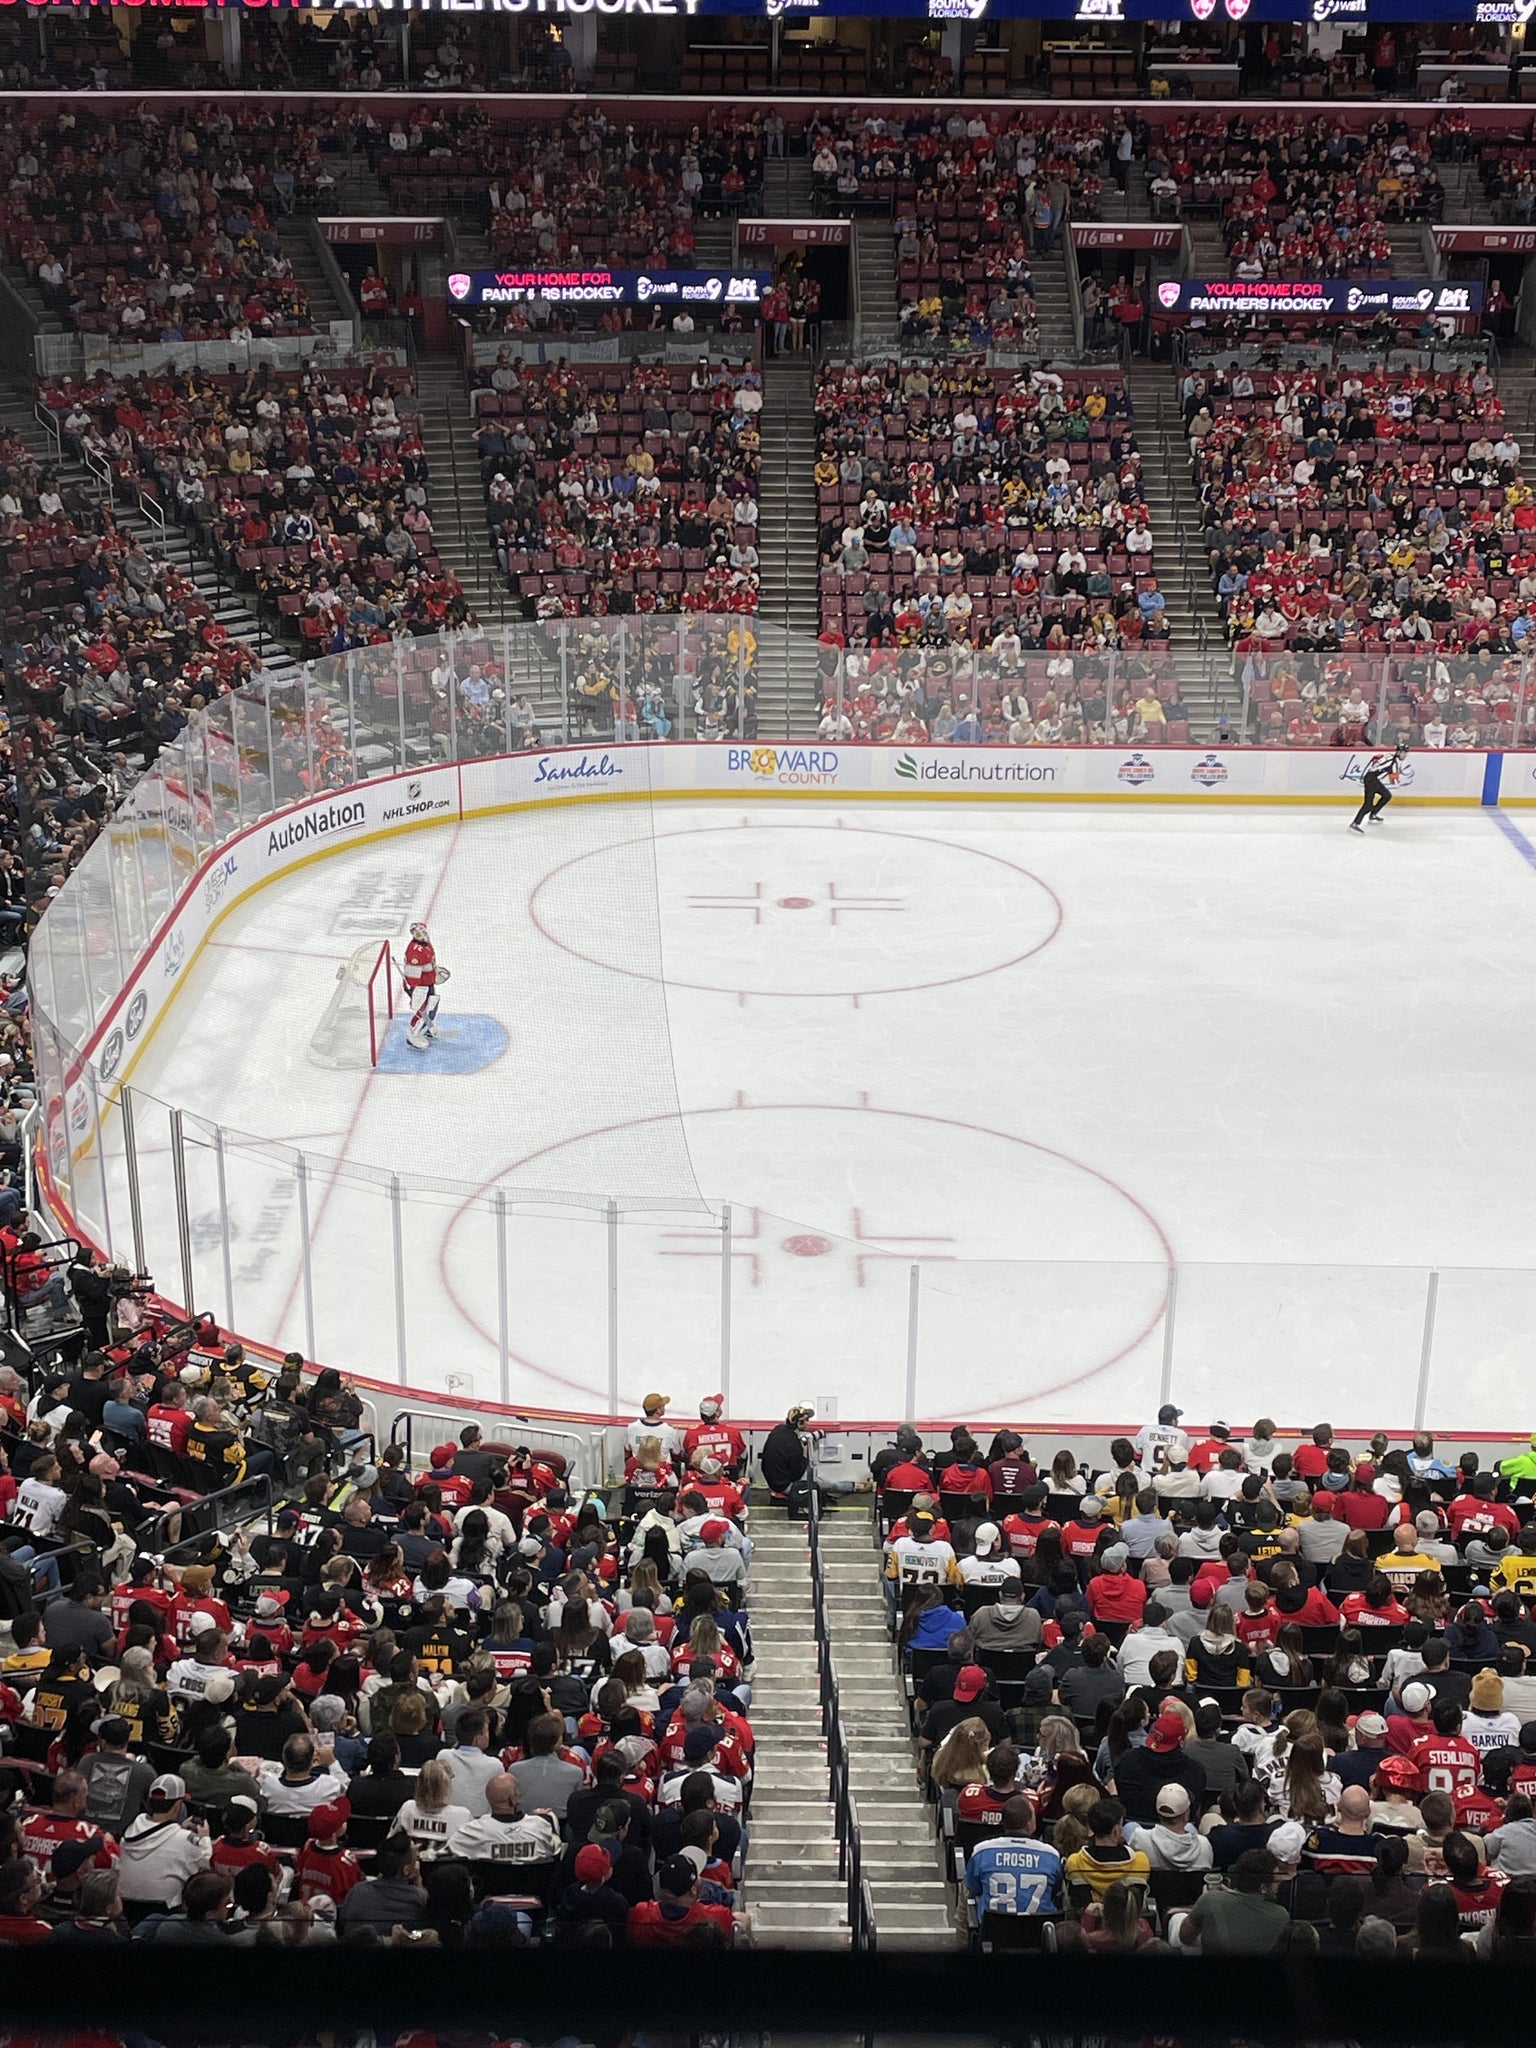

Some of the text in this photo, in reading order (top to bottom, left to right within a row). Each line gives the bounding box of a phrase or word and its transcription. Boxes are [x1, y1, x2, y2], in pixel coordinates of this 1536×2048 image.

[1476, 3, 1514, 13] SOUTH
[325, 225, 350, 240] 114
[413, 225, 435, 240] 115
[745, 226, 767, 242] 115
[821, 227, 843, 242] 116
[1076, 230, 1098, 245] 116
[1153, 231, 1175, 246] 117
[1436, 233, 1459, 248] 117
[1513, 233, 1536, 248] 118
[495, 272, 612, 286] YOUR HOME FOR
[482, 286, 624, 301] PANTRS HOCKEY
[1204, 283, 1323, 297] YOUR HOME FOR
[1190, 297, 1334, 310] PANTHERS HOCKEY
[534, 754, 623, 783] Sandals
[728, 748, 838, 775] BROWARD
[920, 759, 1056, 780] idealnutrition
[778, 773, 838, 785] COUNTY
[268, 802, 365, 856] AutoNation
[1149, 1432, 1178, 1445] BENNETT
[179, 1675, 206, 1691] CROS
[1471, 1734, 1509, 1748] BARKOV
[491, 1841, 536, 1860] CROSBY
[996, 1852, 1040, 1869] CROSBY
[989, 1872, 1048, 1915] 87
